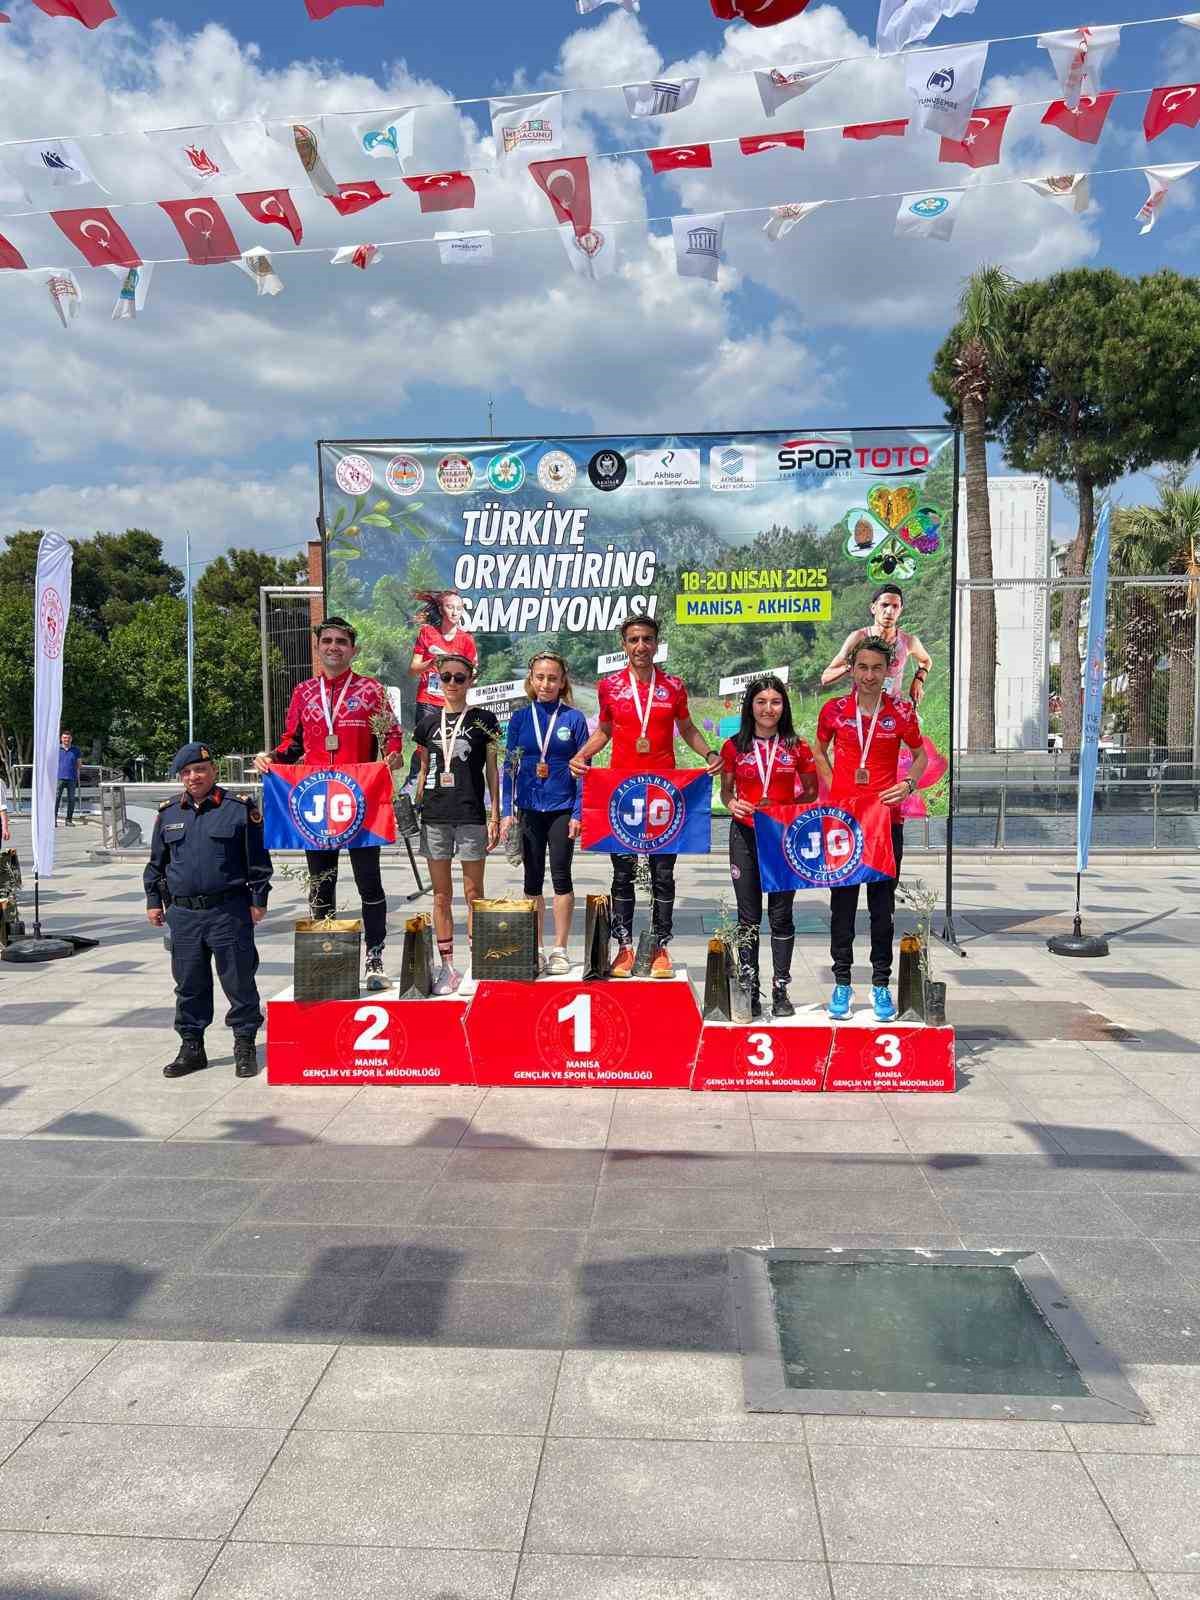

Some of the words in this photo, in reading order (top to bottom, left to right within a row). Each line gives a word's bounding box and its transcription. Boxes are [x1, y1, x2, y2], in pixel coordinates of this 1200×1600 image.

[462, 501, 590, 546] TÜRKİYE
[454, 544, 657, 590] ORYANTİRİNG
[681, 570, 728, 591] 18-20
[731, 567, 782, 590] NİSAN
[785, 567, 828, 589] 2025
[687, 598, 743, 616] MANİSA
[757, 595, 821, 614] AKHİSAR
[297, 771, 357, 793] JANDARMA
[617, 775, 676, 795] JANDARMA
[304, 793, 352, 823] JG
[623, 798, 671, 826] JG
[791, 807, 852, 832] JANDARMA
[800, 829, 850, 859] JG
[353, 1005, 390, 1051] 2
[557, 993, 592, 1053] 1
[354, 1057, 388, 1066] MANİSA
[747, 1032, 774, 1067] 3
[874, 1033, 902, 1067] 3
[303, 1069, 339, 1079] GENÇLİK
[340, 1069, 351, 1077] VE
[352, 1069, 374, 1077] SPOR
[385, 1067, 441, 1078] MÜDÜRLÜĞÜ
[514, 1071, 550, 1081] GENÇLİK
[563, 1071, 586, 1079] SPOR
[597, 1070, 652, 1080] MÜDÜRLÜĞÜ
[566, 1060, 599, 1069] MANİSA
[705, 1079, 735, 1087] GENÇLİK
[833, 1079, 862, 1087] GENÇLİK
